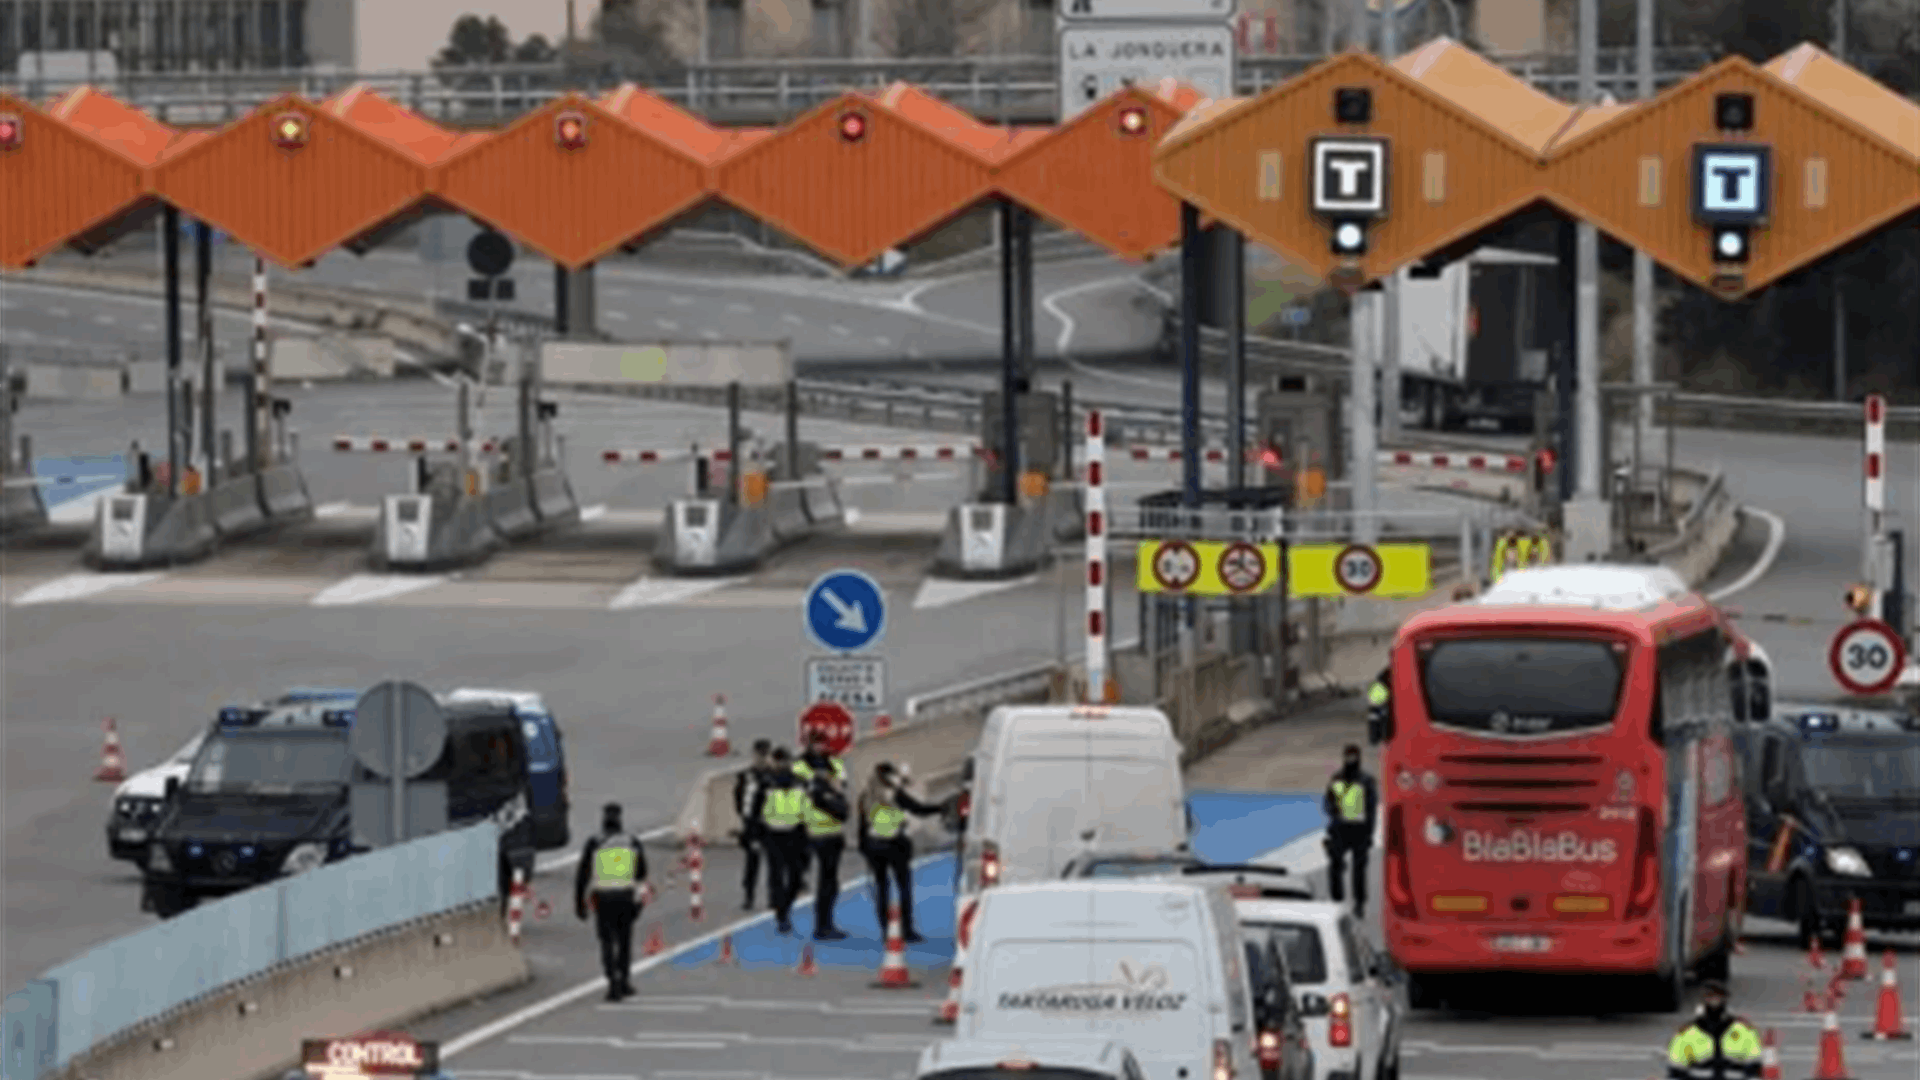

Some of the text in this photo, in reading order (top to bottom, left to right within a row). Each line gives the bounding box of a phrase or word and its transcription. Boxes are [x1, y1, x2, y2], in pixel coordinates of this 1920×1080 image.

[1069, 42, 1097, 59] LA
[1329, 160, 1368, 196] T
[1713, 167, 1751, 202] T
[1346, 559, 1373, 579] 30
[1847, 642, 1889, 670] 30
[1462, 829, 1619, 863] BlaBlaBus
[327, 1041, 422, 1066] CONTROL
